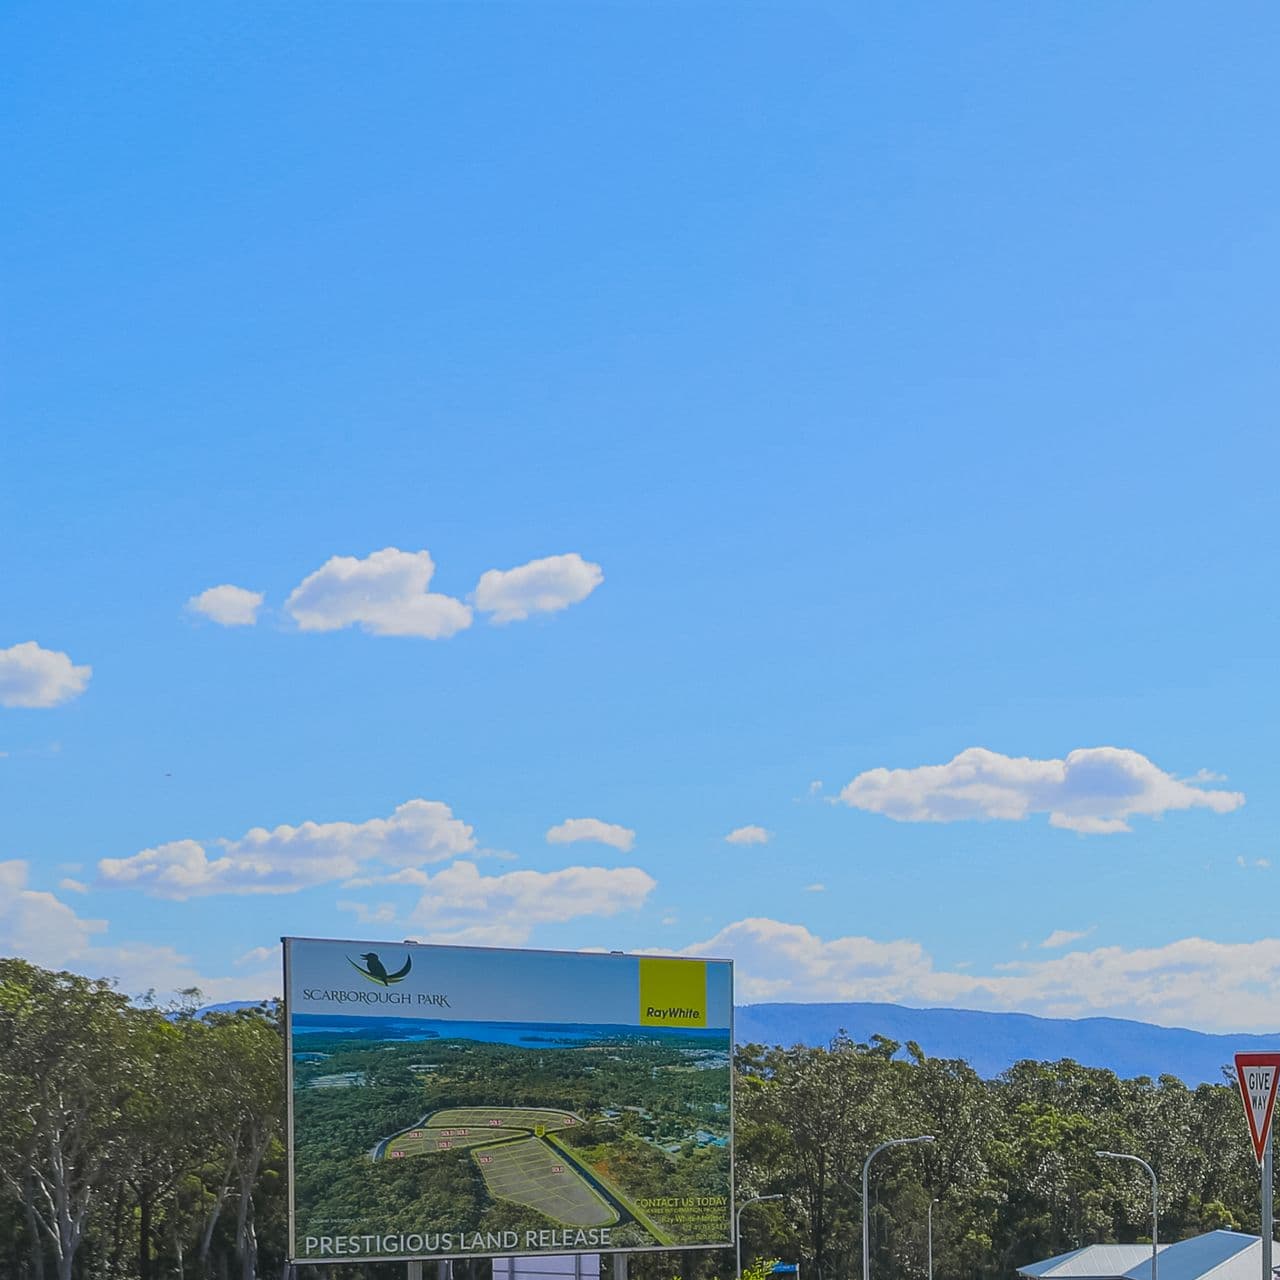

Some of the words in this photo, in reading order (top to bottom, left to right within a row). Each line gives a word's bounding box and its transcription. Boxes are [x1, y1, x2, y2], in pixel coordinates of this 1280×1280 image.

[303, 989, 411, 1005] SCARBOROUGH
[417, 994, 451, 1009] PARK
[1249, 1073, 1270, 1090] GIVE
[1252, 1095, 1267, 1110] WAY
[634, 1198, 679, 1208] CONTACT
[681, 1198, 694, 1207] US
[697, 1197, 728, 1206] TODAY
[306, 1233, 452, 1255] PRESTIGIOUS
[460, 1231, 518, 1250] LAND
[526, 1228, 611, 1247] RELEASE
